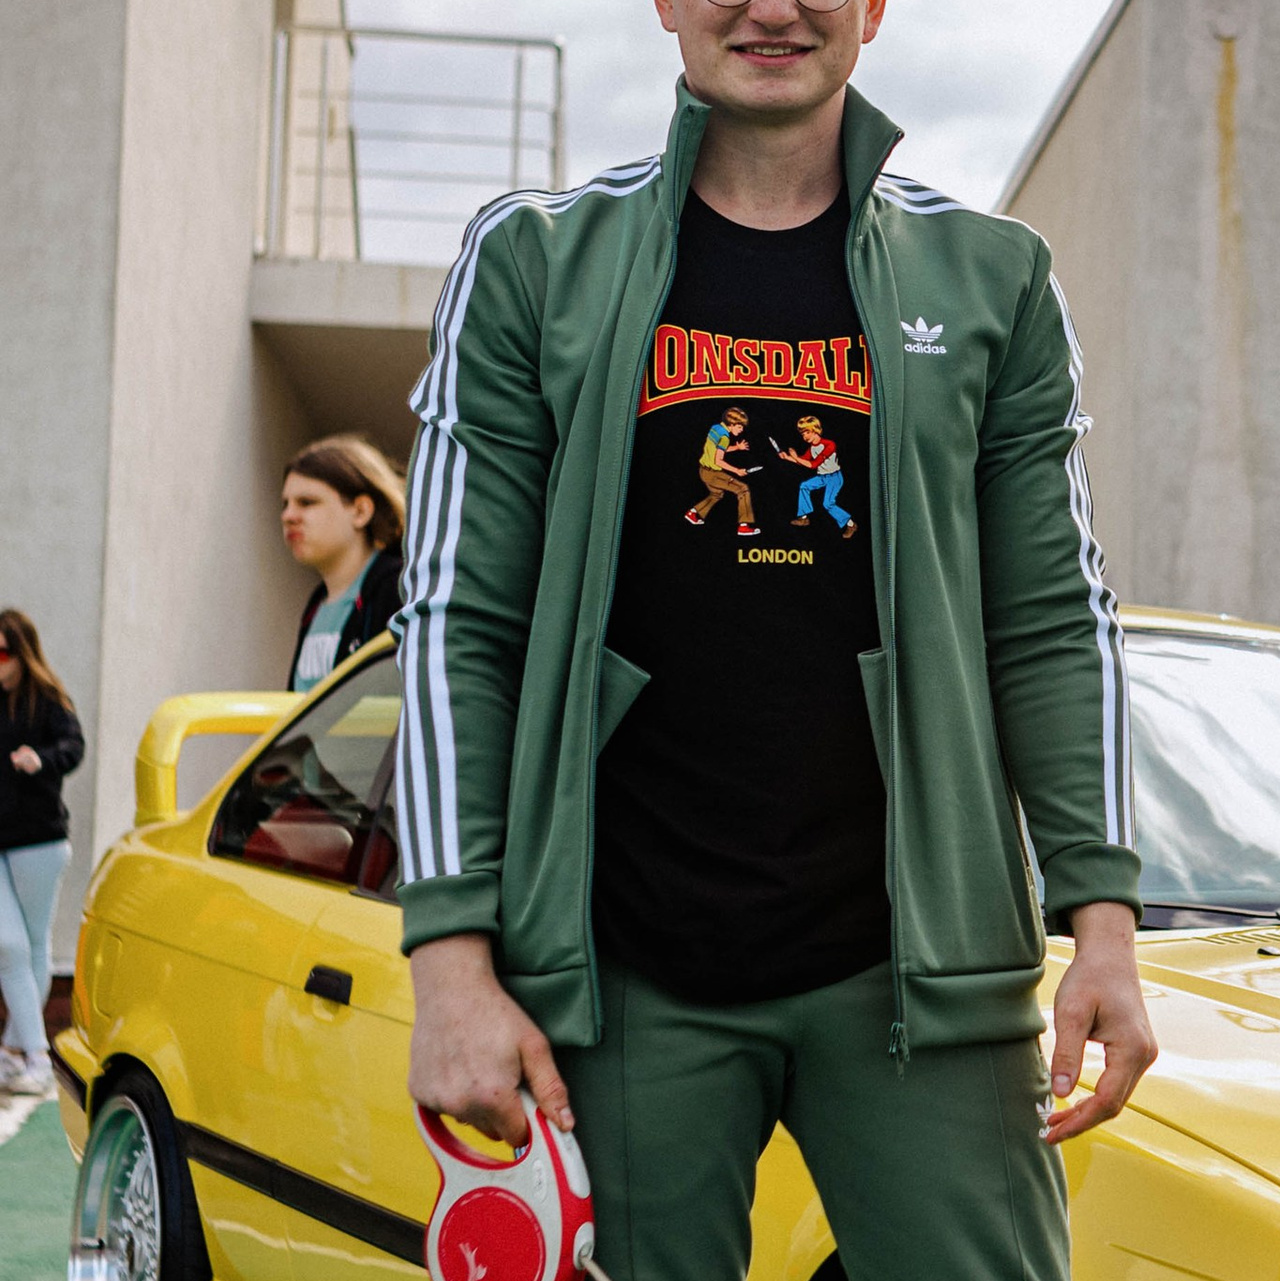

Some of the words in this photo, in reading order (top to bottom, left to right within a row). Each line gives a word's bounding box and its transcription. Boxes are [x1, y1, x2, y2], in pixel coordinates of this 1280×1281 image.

[904, 342, 947, 354] adidas
[643, 323, 872, 401] ONSDAL
[738, 548, 814, 565] LONDON
